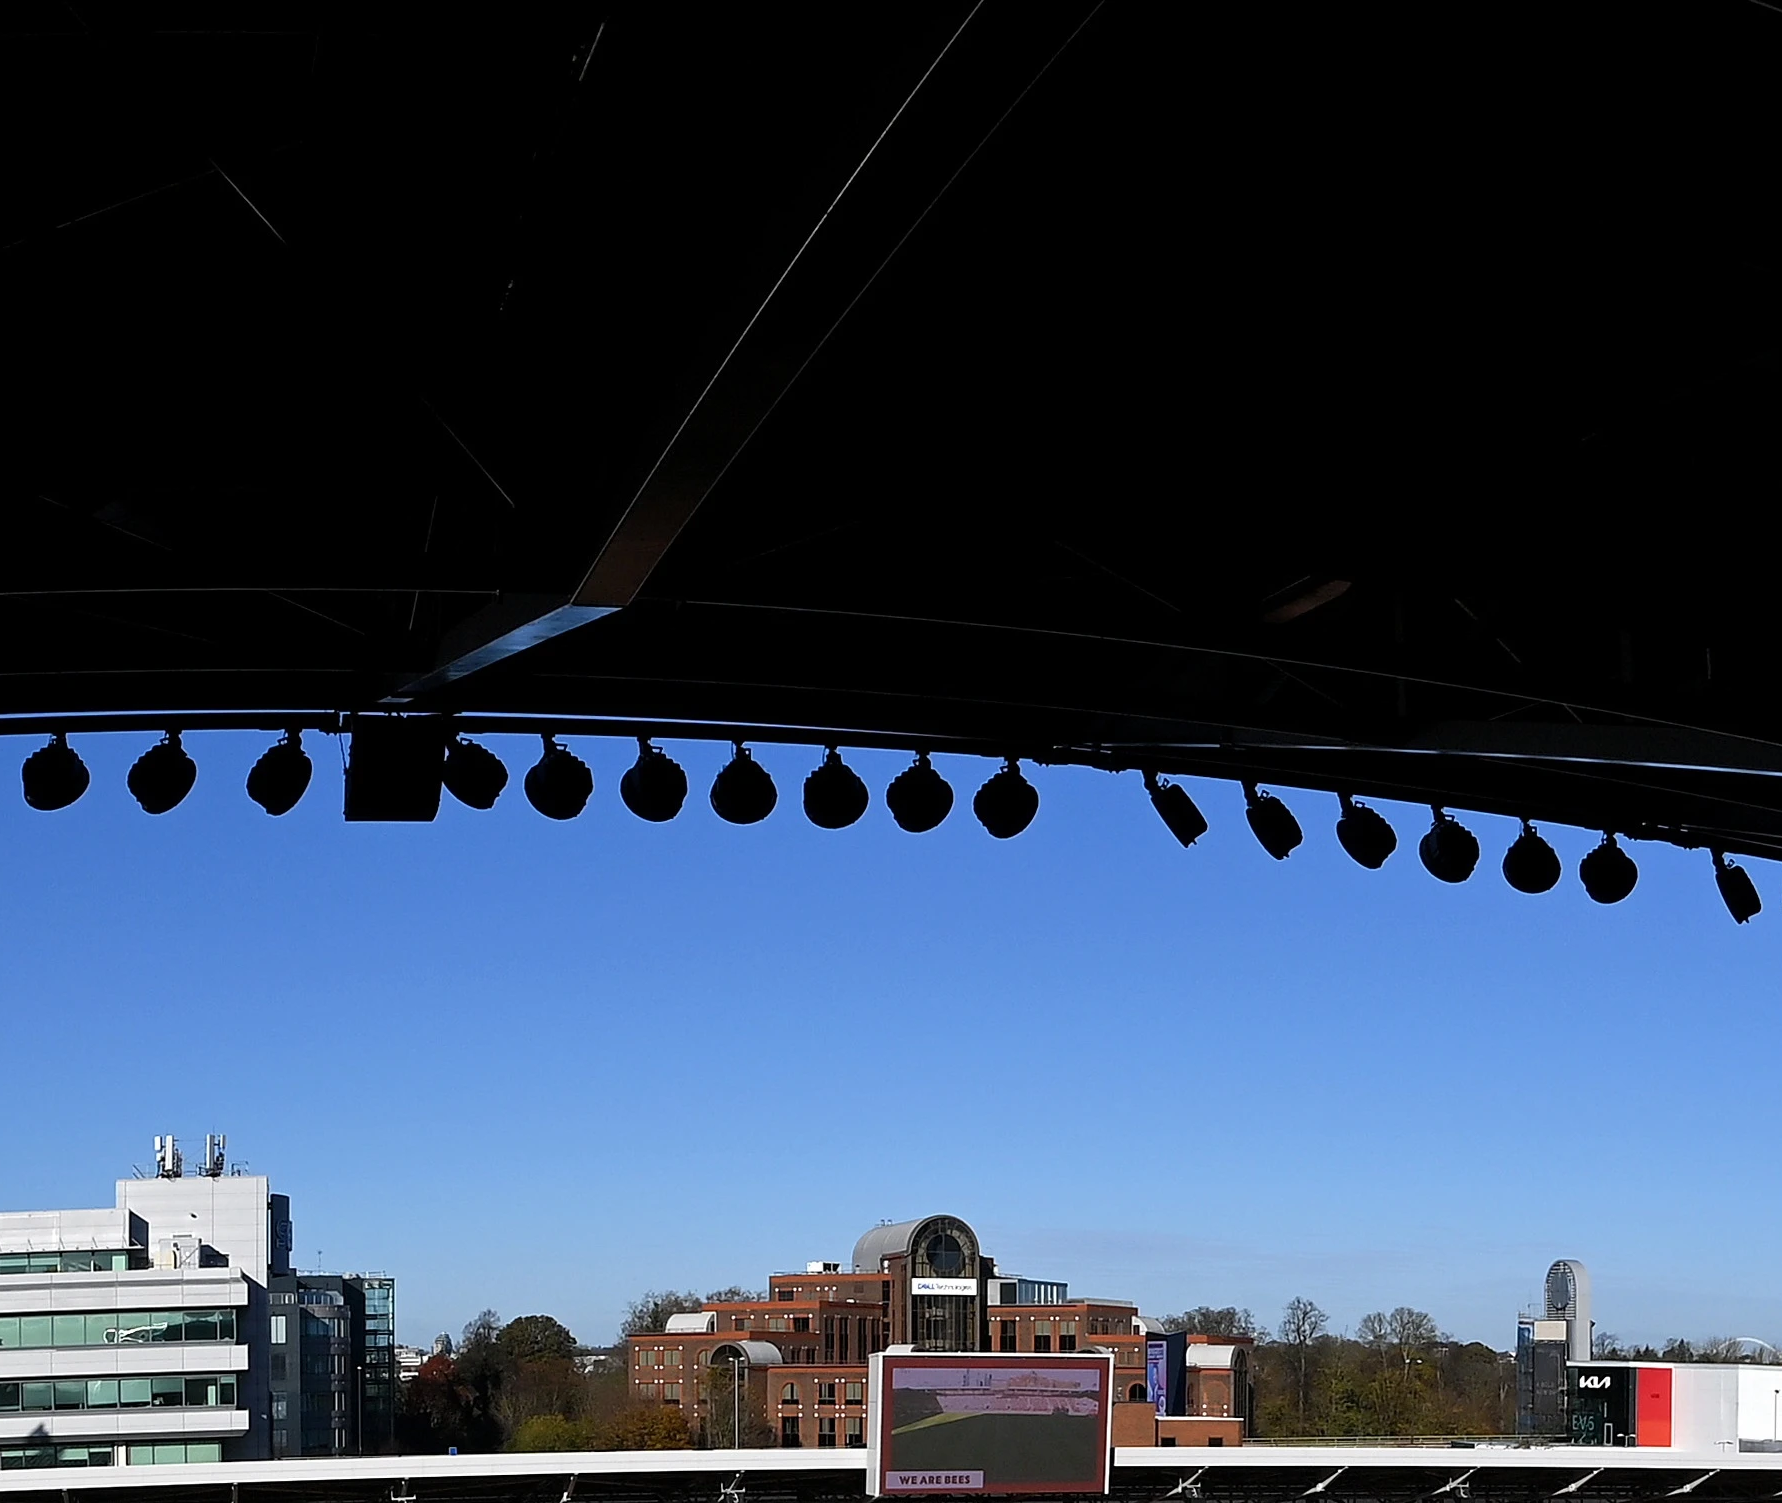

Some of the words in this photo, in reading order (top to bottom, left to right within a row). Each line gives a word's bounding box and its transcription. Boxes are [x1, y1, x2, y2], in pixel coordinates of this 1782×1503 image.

[899, 1475, 918, 1485] WE
[919, 1475, 942, 1485] ARE
[944, 1475, 971, 1484] BEES
